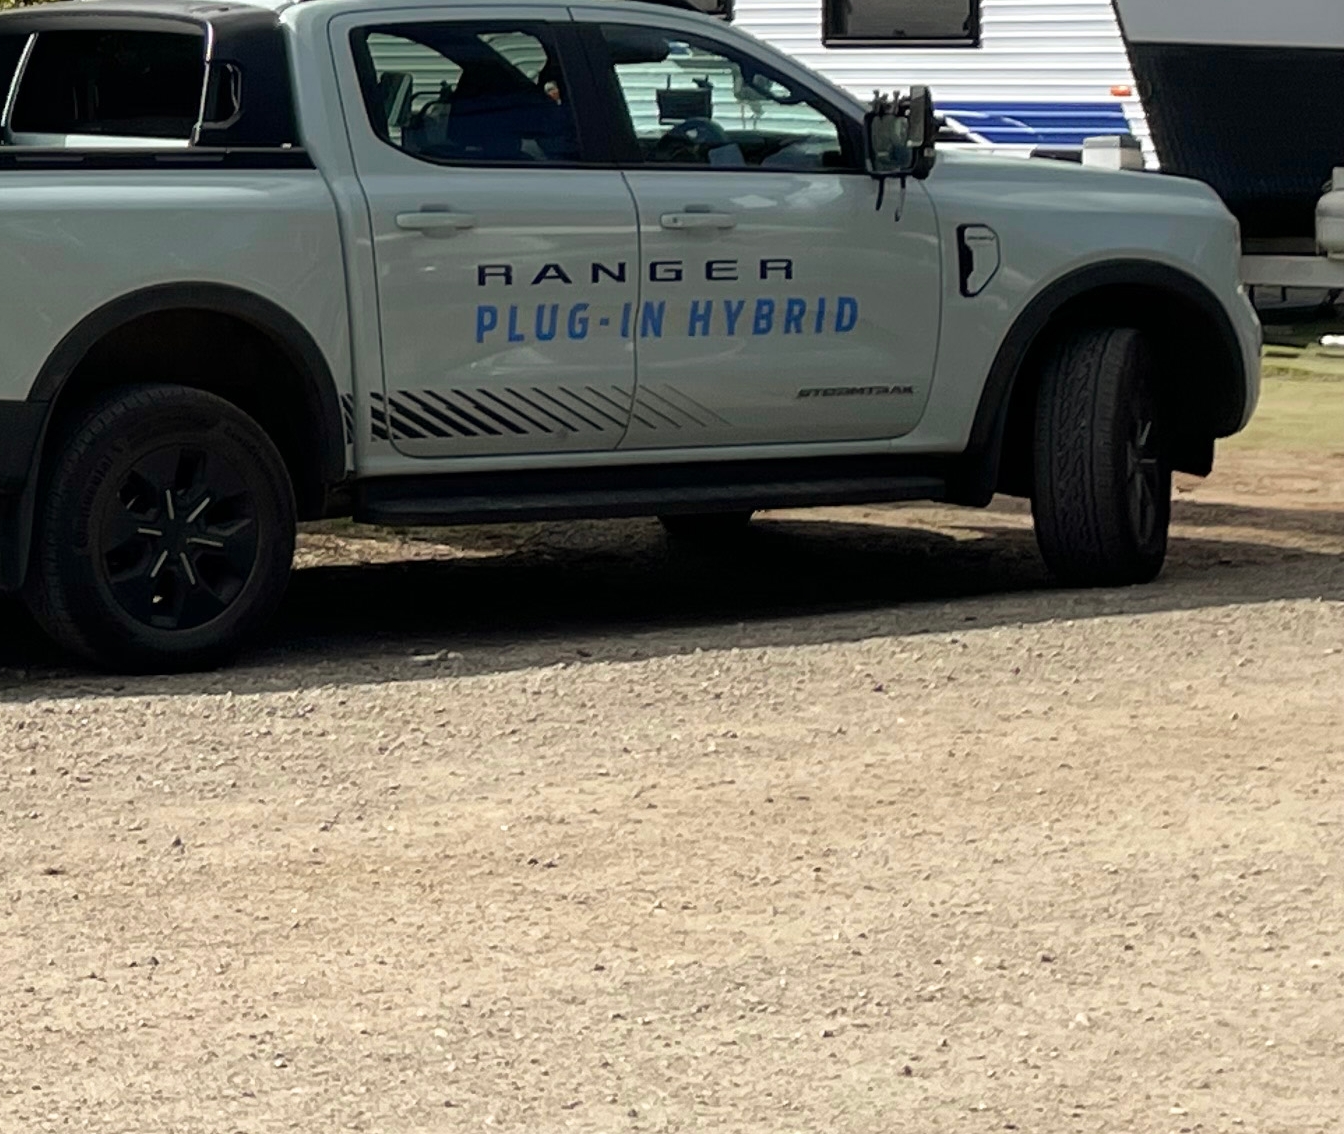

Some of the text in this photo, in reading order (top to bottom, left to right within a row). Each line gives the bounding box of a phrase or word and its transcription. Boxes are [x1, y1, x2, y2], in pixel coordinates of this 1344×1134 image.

[477, 258, 793, 287] RANGER
[475, 296, 859, 344] PLUG-IN HYBRID
